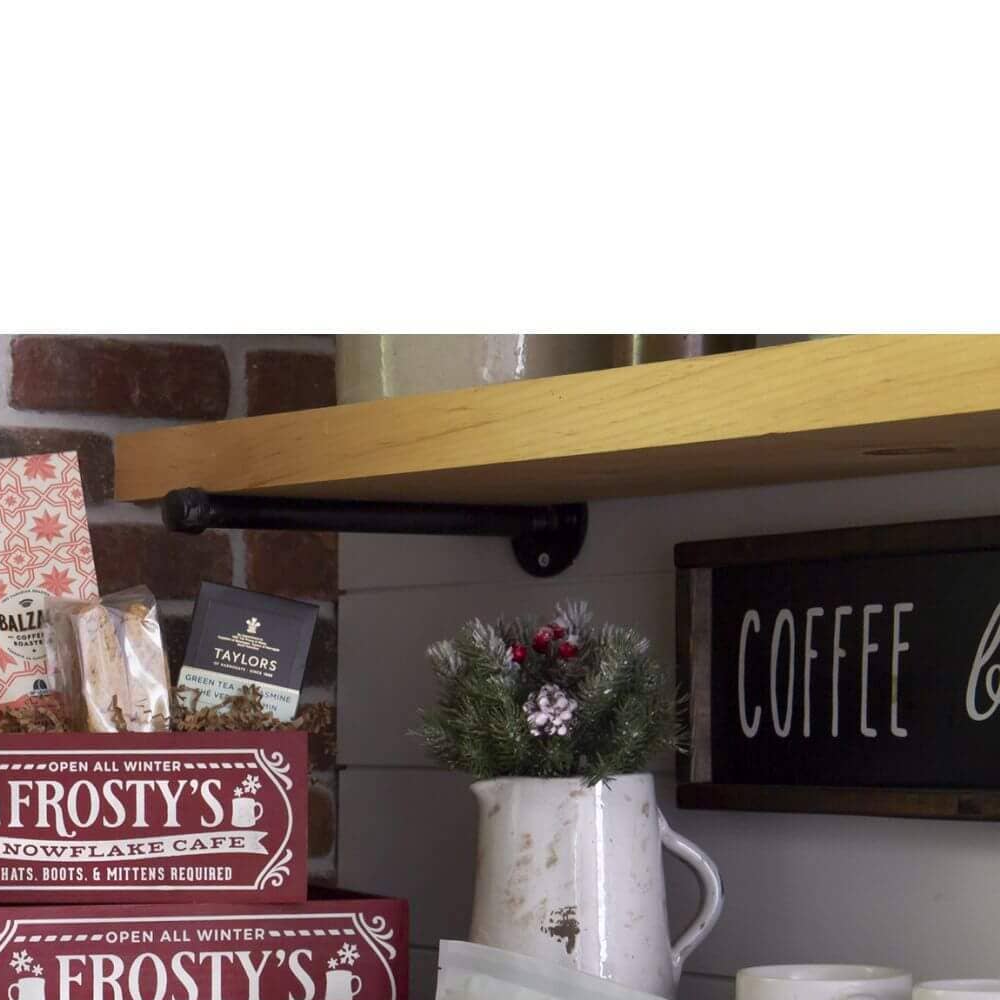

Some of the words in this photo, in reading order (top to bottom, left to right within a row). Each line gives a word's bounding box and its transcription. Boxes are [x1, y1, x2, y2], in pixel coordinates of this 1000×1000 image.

[214, 647, 278, 672] TAYLORS
[738, 602, 914, 738] COFFEE
[185, 674, 215, 686] GREEN
[218, 680, 234, 690] TEA
[48, 761, 89, 773] OPEN
[94, 761, 119, 773] ALL
[123, 760, 181, 773] WINTER
[7, 779, 225, 838] FROSTY'S
[172, 836, 246, 852] CAFE
[92, 867, 101, 881] &
[106, 867, 165, 882] MITTENS
[171, 866, 233, 881] REQUIRED
[106, 930, 153, 944] OPEN
[160, 929, 191, 942] ALL
[197, 928, 265, 942] WINTER
